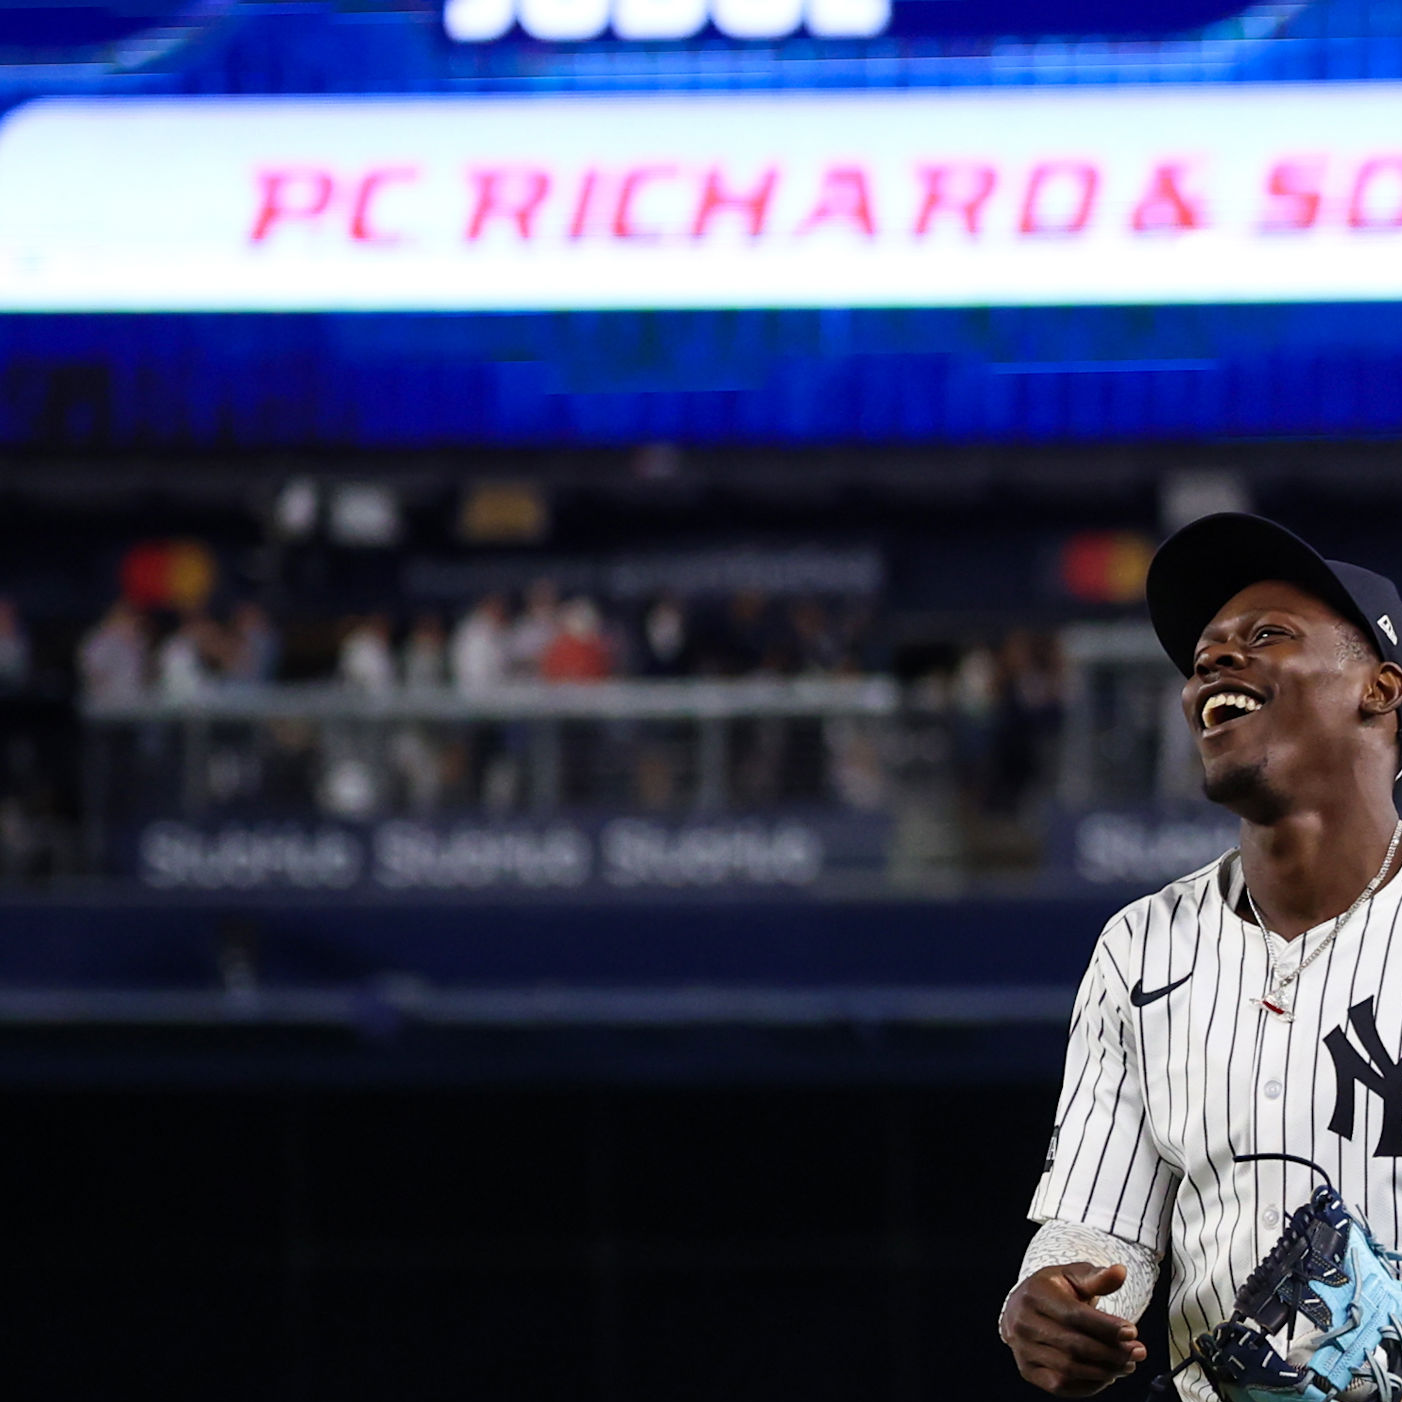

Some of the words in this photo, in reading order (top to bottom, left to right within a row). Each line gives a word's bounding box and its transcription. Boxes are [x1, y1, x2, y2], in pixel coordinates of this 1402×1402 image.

[248, 162, 420, 250] PC
[464, 158, 1100, 248] RICHARD
[1128, 158, 1202, 240] &
